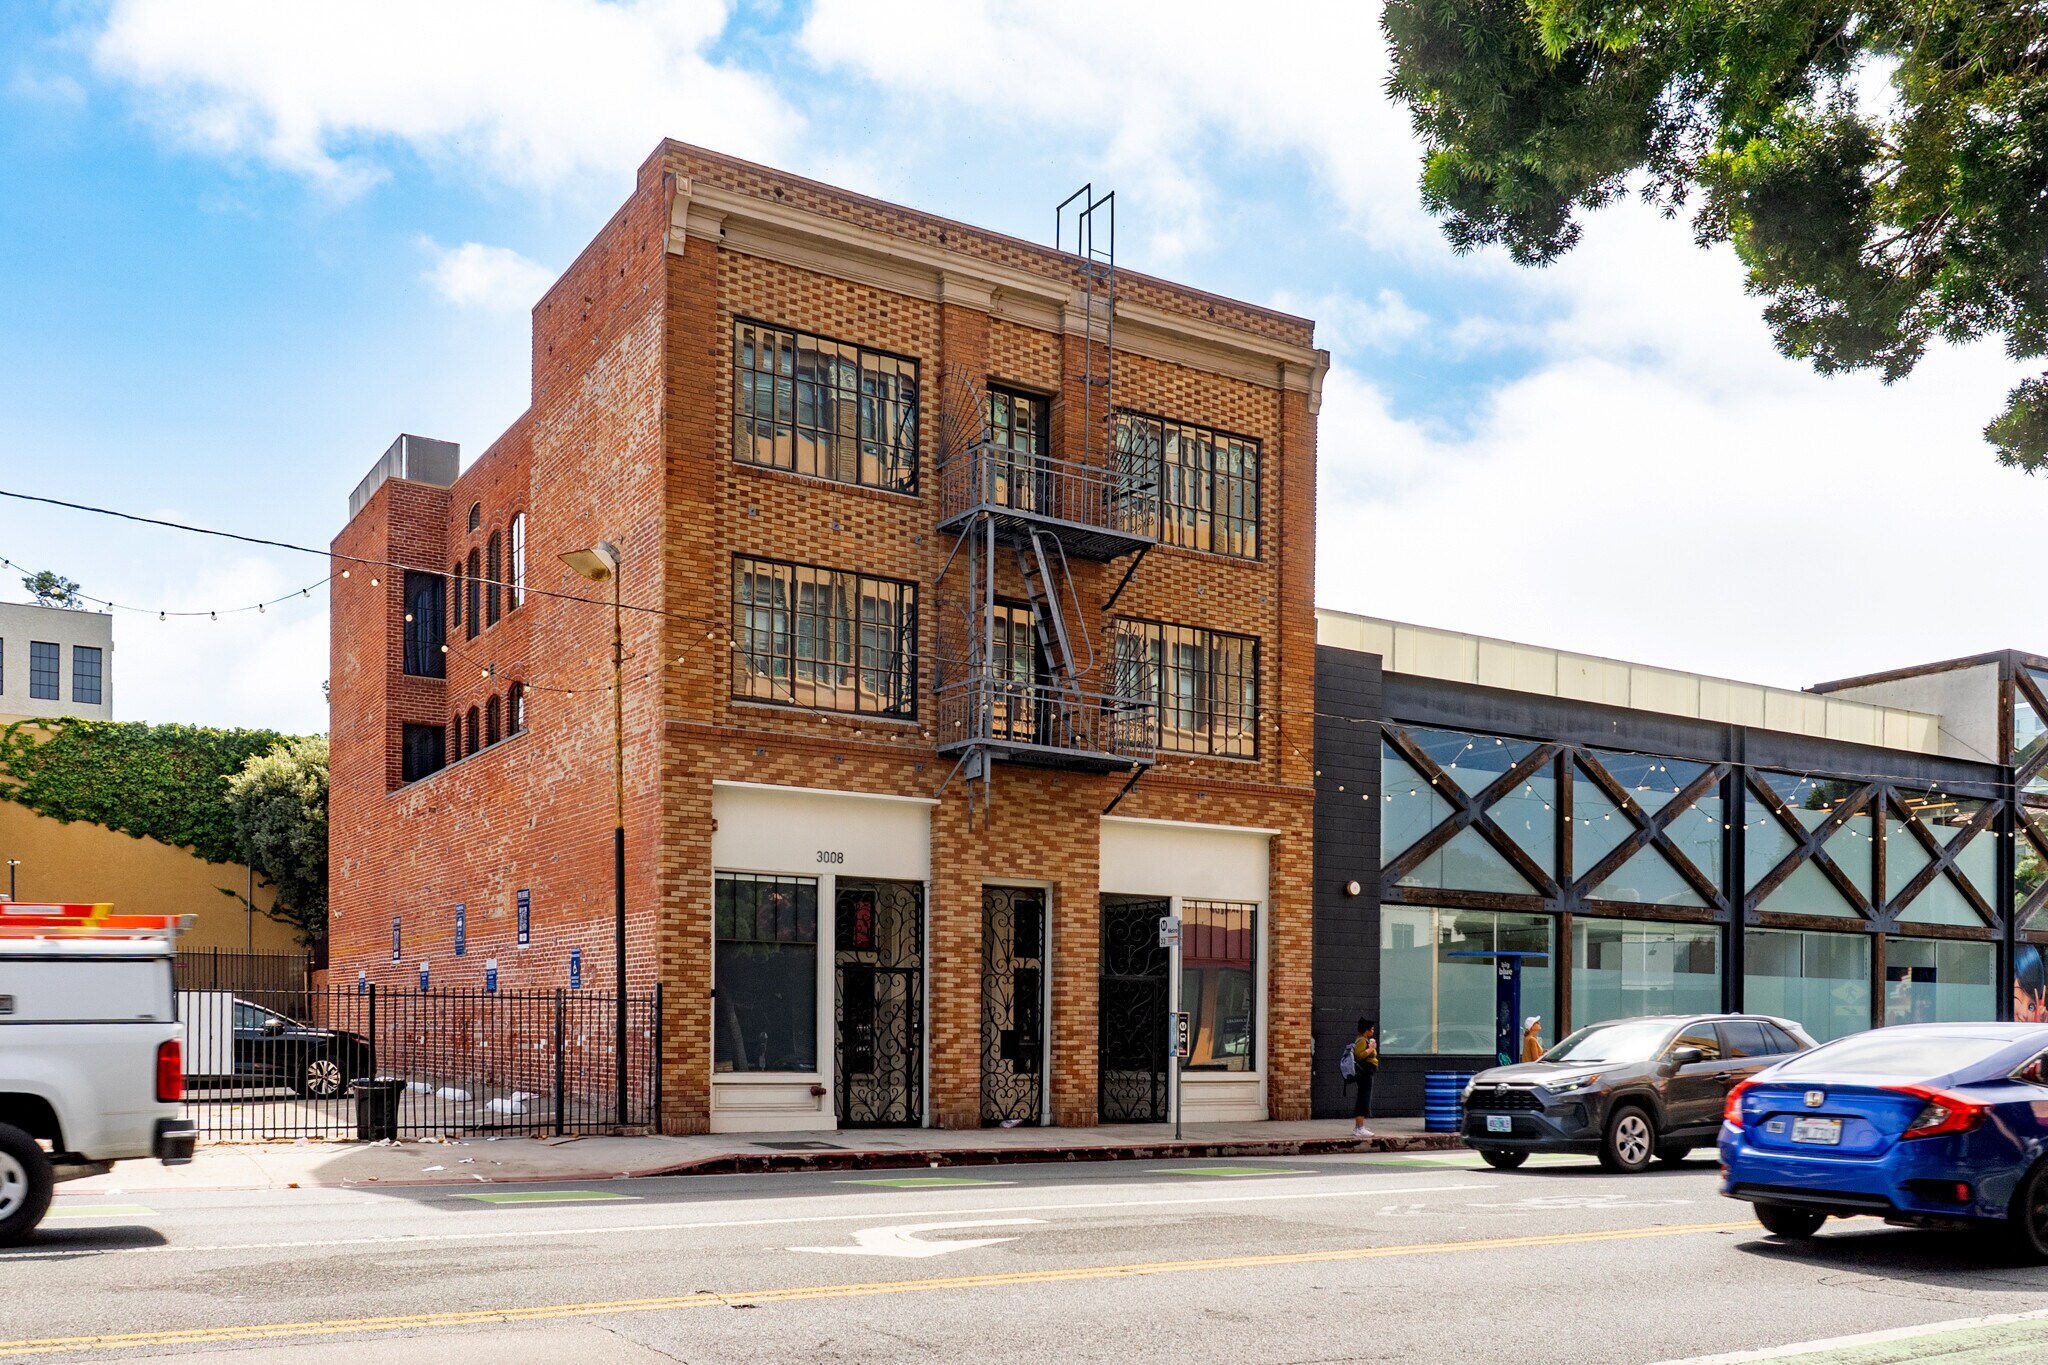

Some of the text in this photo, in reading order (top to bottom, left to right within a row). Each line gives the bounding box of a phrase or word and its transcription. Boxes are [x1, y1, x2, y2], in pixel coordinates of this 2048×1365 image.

[816, 850, 844, 864] 3008
[1501, 961, 1510, 969] big
[1499, 967, 1513, 975] blue
